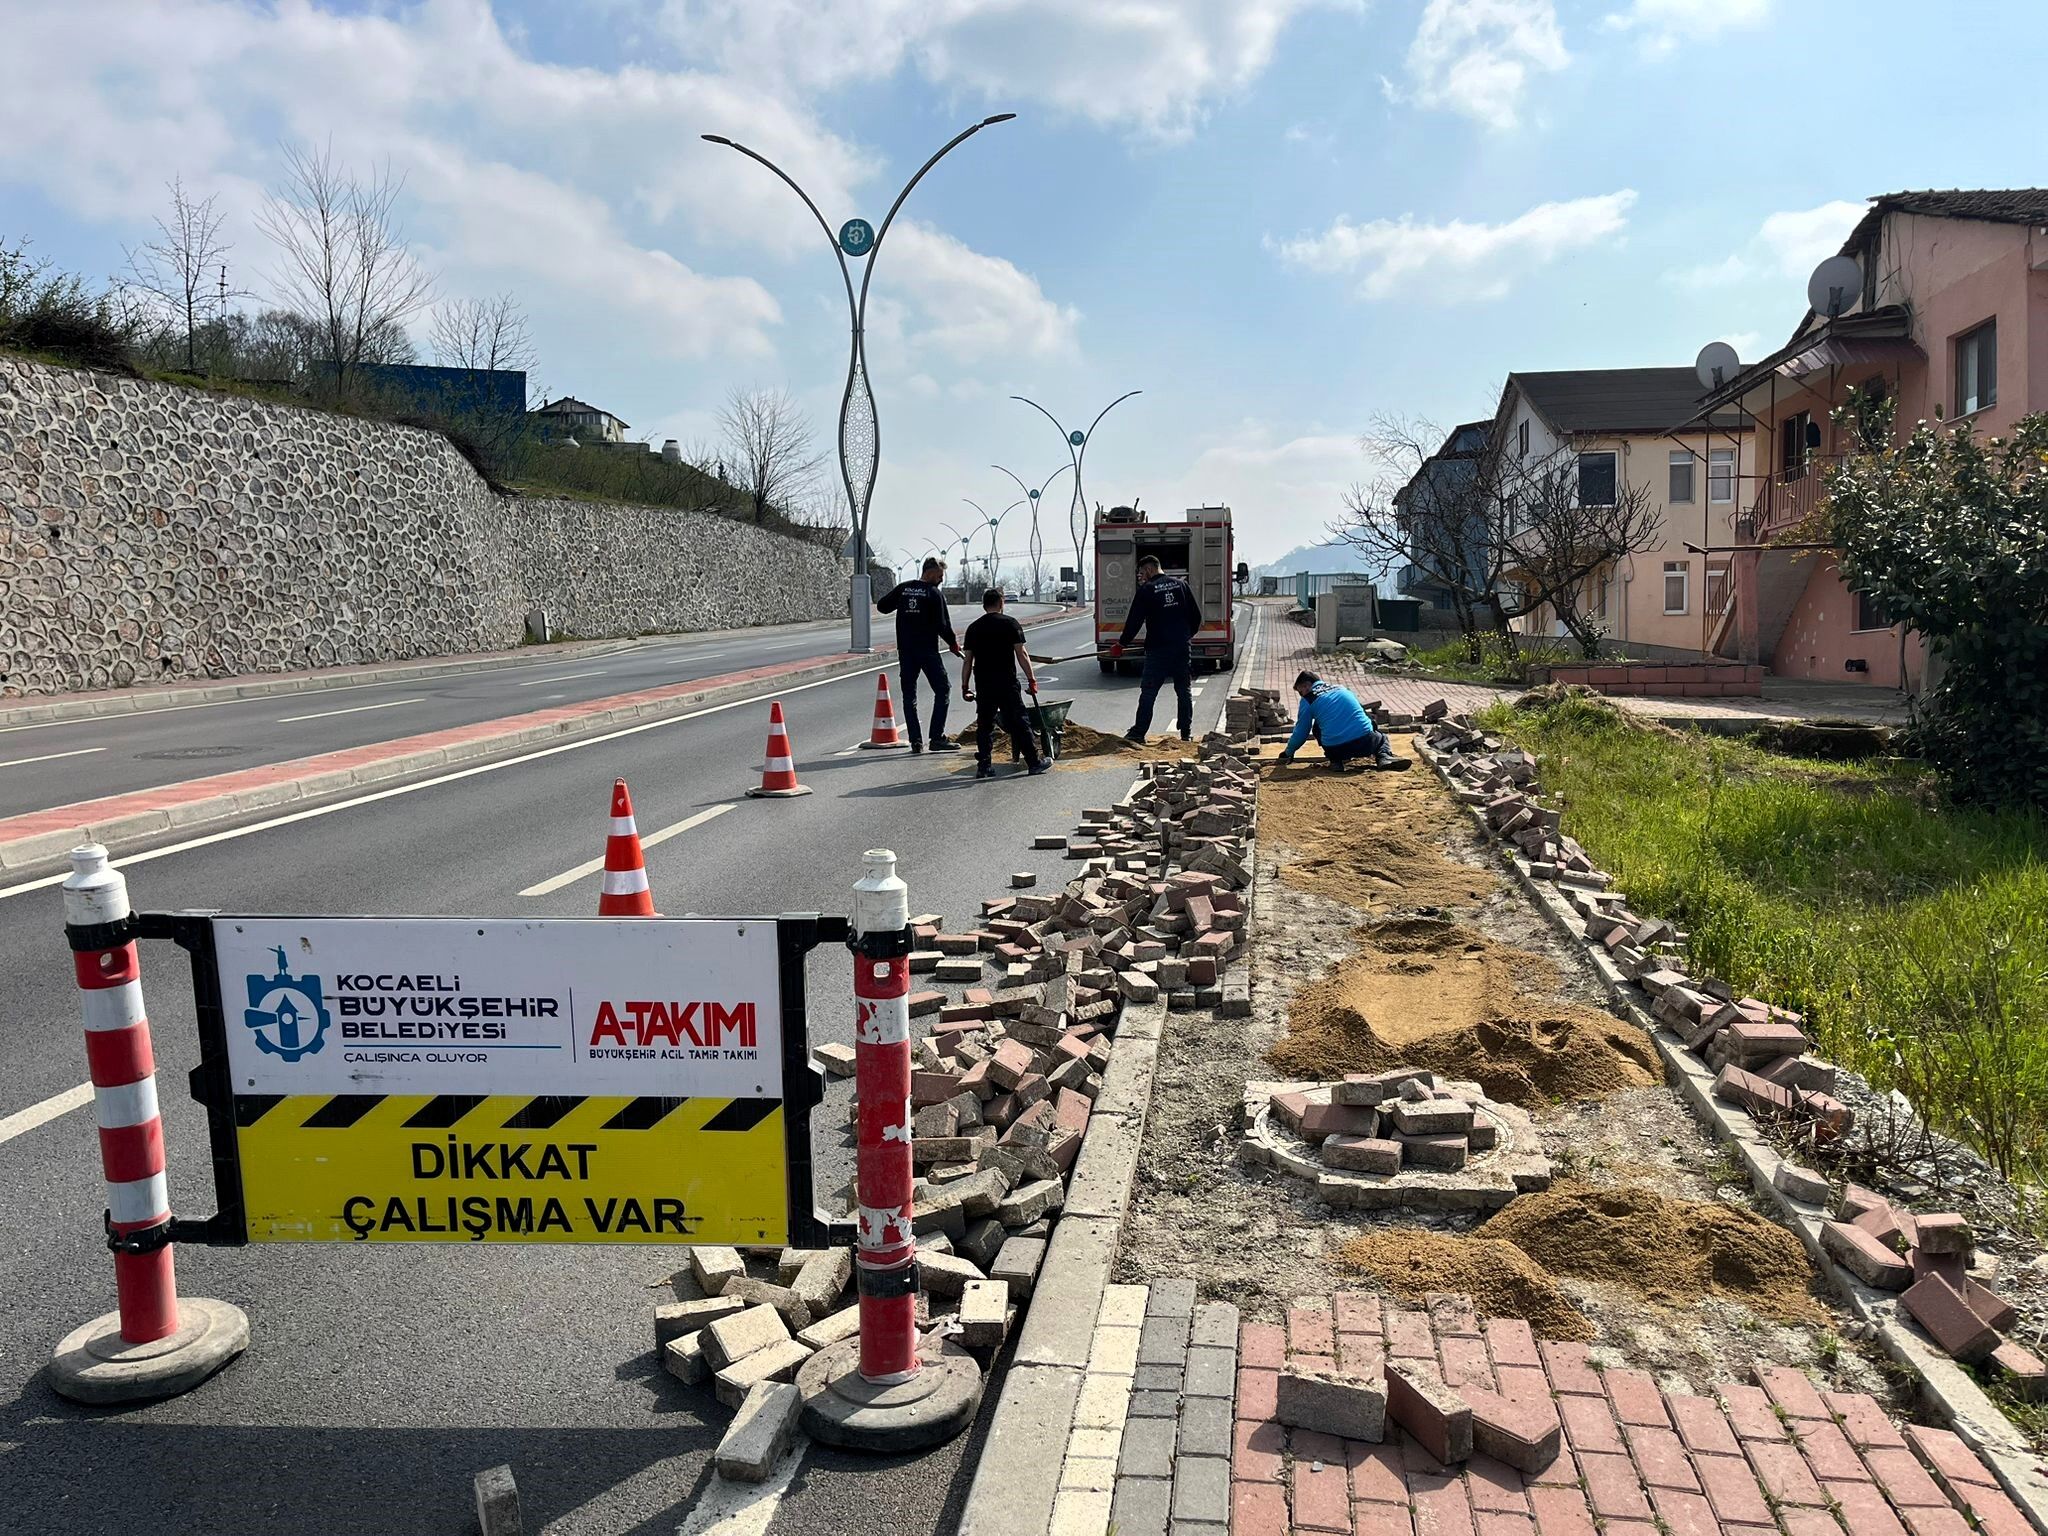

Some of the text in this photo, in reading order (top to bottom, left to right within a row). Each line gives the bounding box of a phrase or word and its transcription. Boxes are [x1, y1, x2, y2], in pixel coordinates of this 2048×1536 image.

[337, 975, 460, 991] KOCAELİ
[339, 997, 559, 1020] BÜYÜKŞEHİR
[341, 1022, 506, 1039] BELEDİYESİ
[590, 1001, 757, 1047] A-TAKIMI
[344, 1053, 487, 1063] ÇALIŞINCA OLUYOR
[589, 1049, 758, 1061] BÜYÜKŞEHİR ACİL TAMİR TAKIMI
[411, 1133, 598, 1180] DİKKAT
[343, 1196, 690, 1241] ÇALIŞMA VAR
